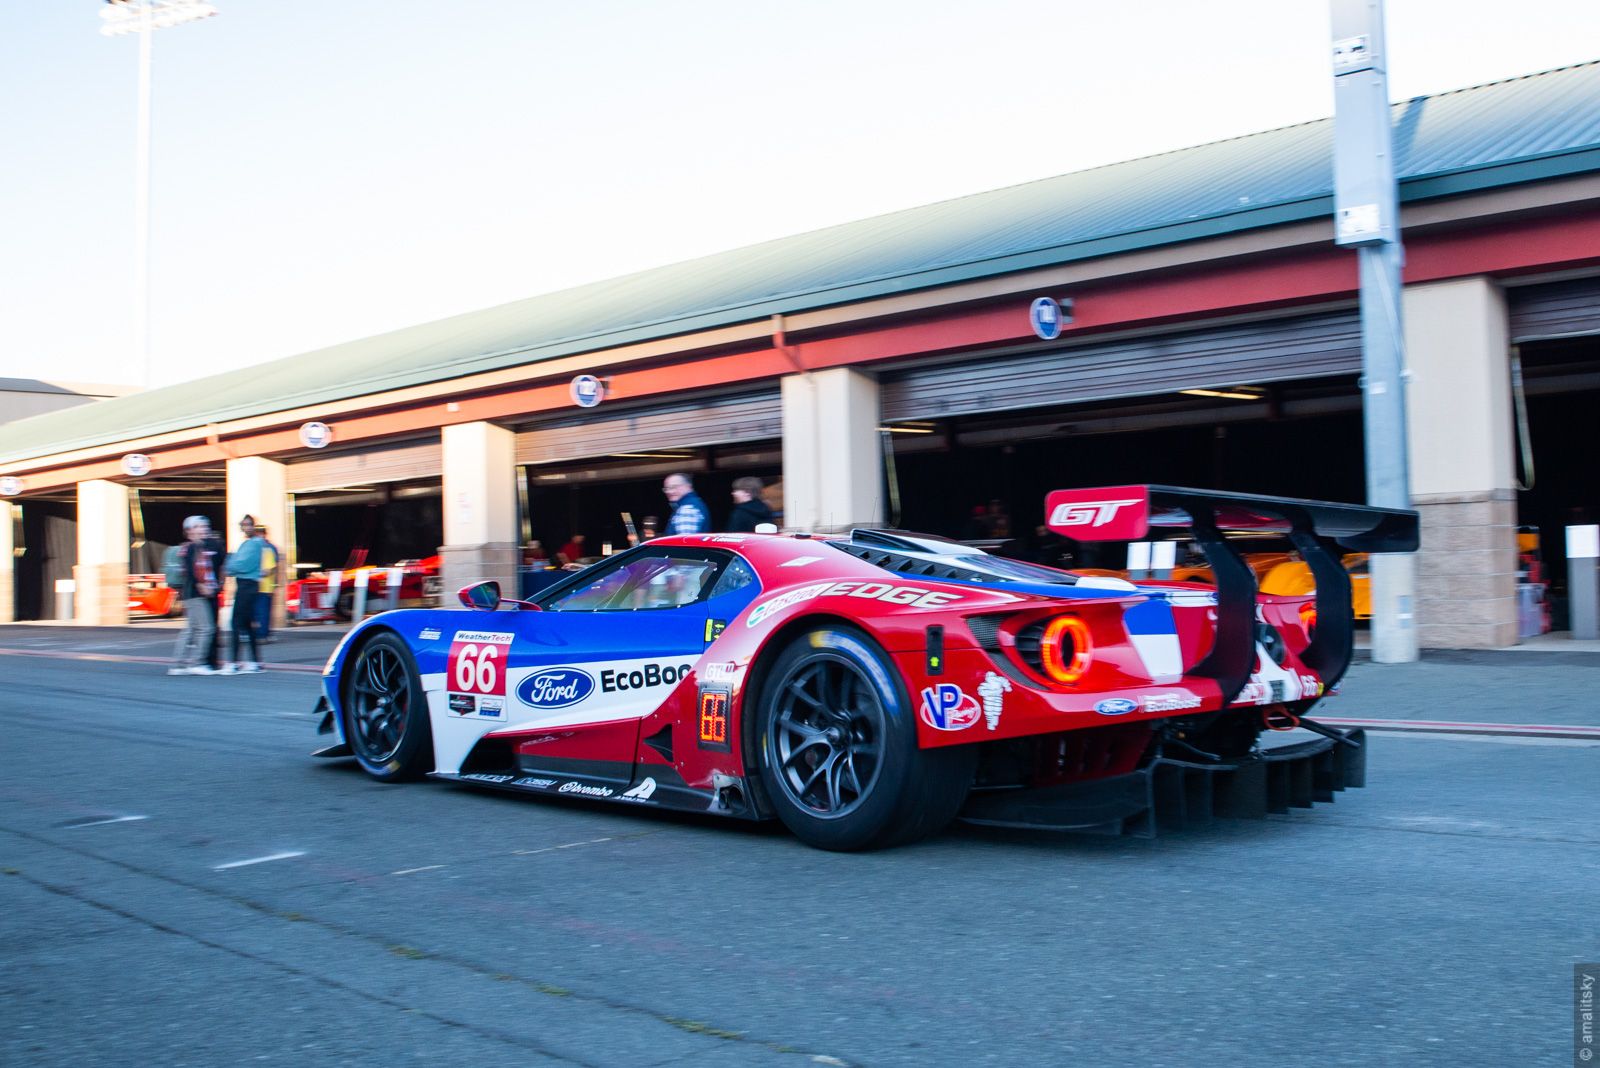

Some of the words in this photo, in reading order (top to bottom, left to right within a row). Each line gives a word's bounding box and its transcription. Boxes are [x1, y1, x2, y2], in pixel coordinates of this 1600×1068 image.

[1049, 499, 1144, 527] GT
[819, 582, 964, 609] EDGE
[458, 632, 512, 642] WeatherTech
[456, 643, 498, 693] 66
[531, 674, 578, 702] Ford
[700, 693, 726, 741] 66
[922, 684, 962, 729] VP
